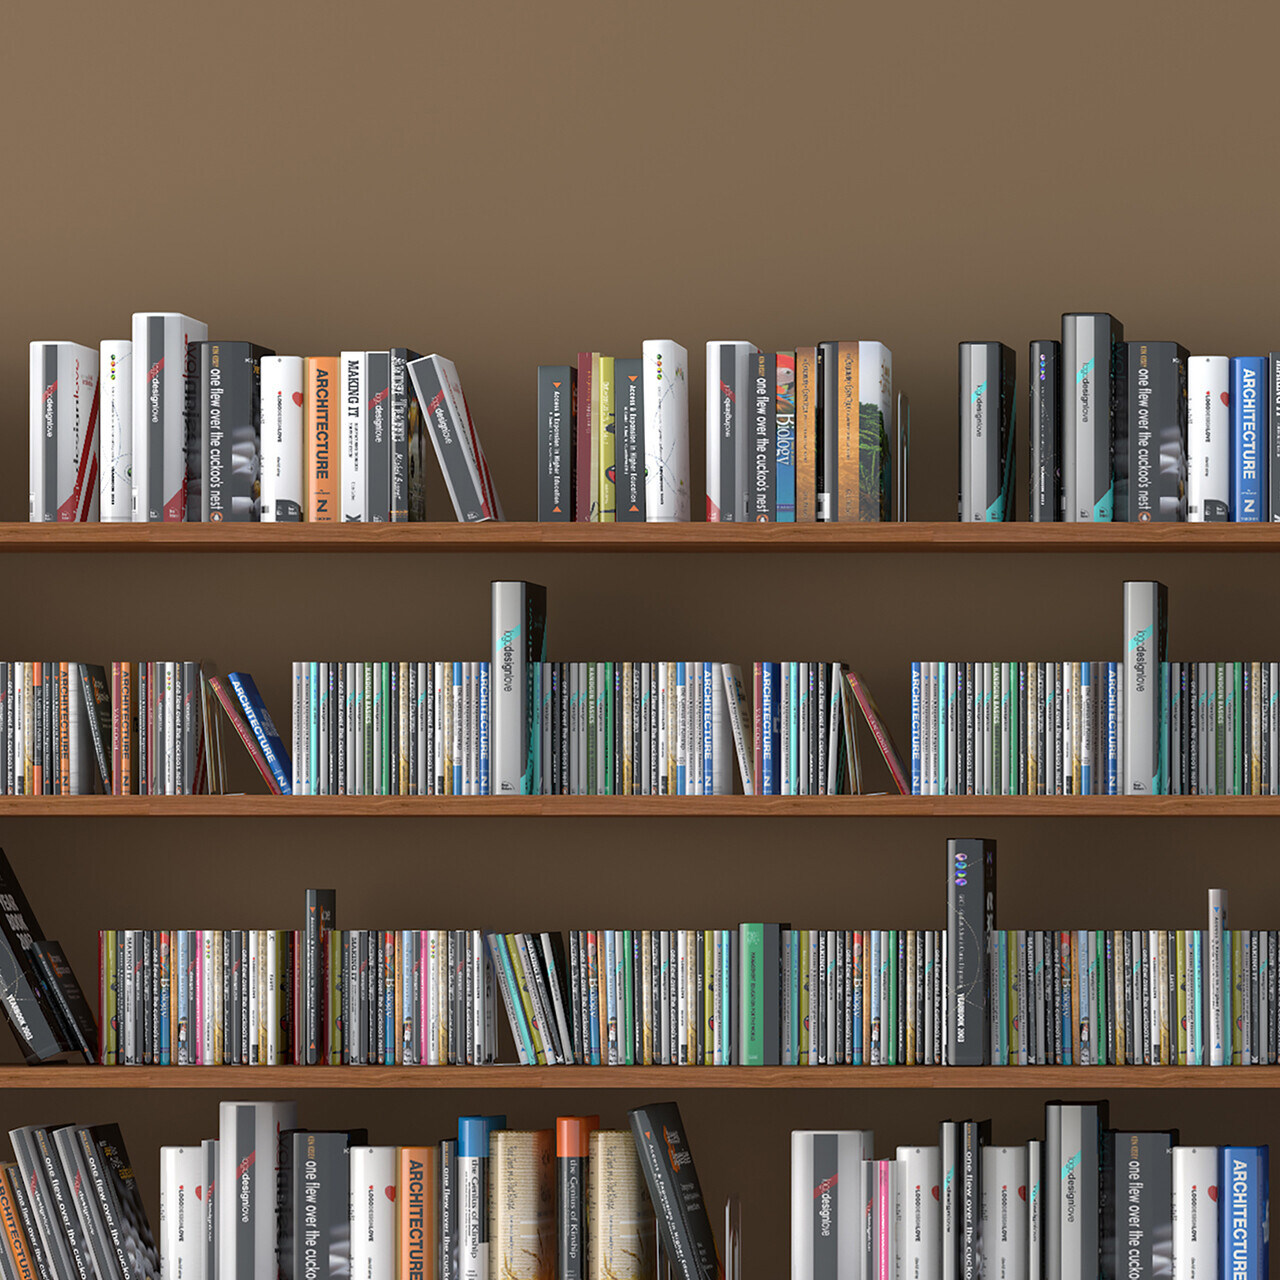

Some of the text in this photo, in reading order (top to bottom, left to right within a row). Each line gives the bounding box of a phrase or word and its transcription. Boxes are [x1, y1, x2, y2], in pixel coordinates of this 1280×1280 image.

[348, 361, 359, 417] MAKING IT
[211, 369, 223, 509] one flew over the cuckoo's nest
[316, 369, 328, 479] ARCHITECTURE
[777, 414, 794, 464] Biology
[1138, 369, 1152, 509] one flew over the cuckoo's nest
[1243, 369, 1255, 479] ARCHITECTURE
[232, 681, 276, 763] ARCHITECTURE
[306, 1161, 316, 1180] one
[306, 1183, 320, 1203] flew
[570, 1176, 578, 1209] Genius
[89, 1157, 98, 1177] one
[95, 1179, 106, 1201] flew
[103, 1203, 114, 1226] over
[111, 1228, 120, 1246] the
[306, 1205, 316, 1227] over
[410, 1160, 423, 1280] ARCHITECTURE
[570, 1211, 577, 1222] of
[1233, 1160, 1247, 1280] ARCHITECTURE
[306, 1231, 320, 1246] the
[568, 1223, 577, 1259] Kinship
